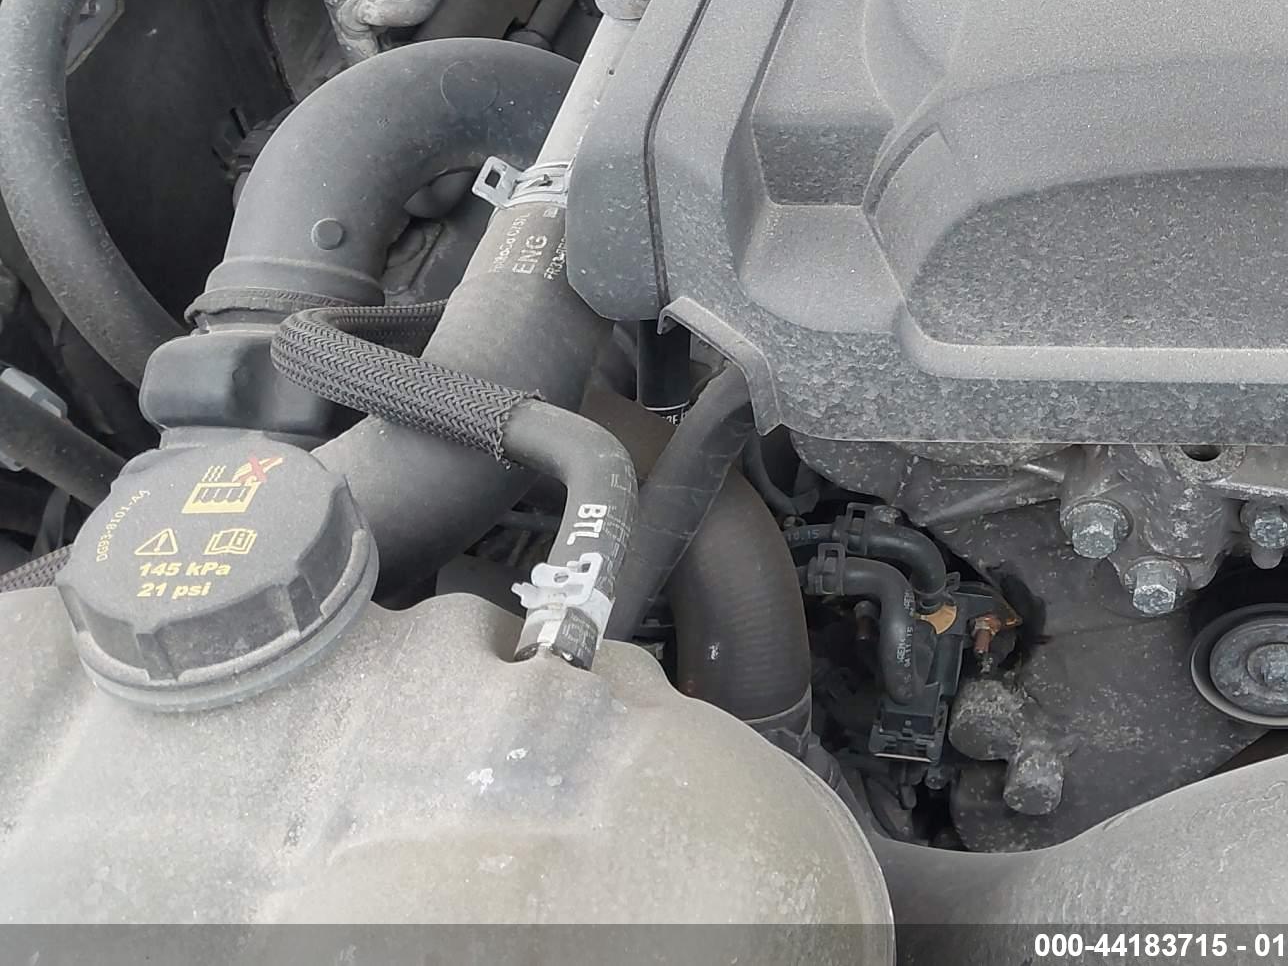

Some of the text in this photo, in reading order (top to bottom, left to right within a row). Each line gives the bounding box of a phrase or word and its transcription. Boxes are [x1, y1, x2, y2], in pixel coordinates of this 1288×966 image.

[512, 235, 548, 274] ENG
[566, 503, 608, 546] BTL
[139, 561, 232, 576] 145 kPa
[137, 582, 212, 600] 21 psi
